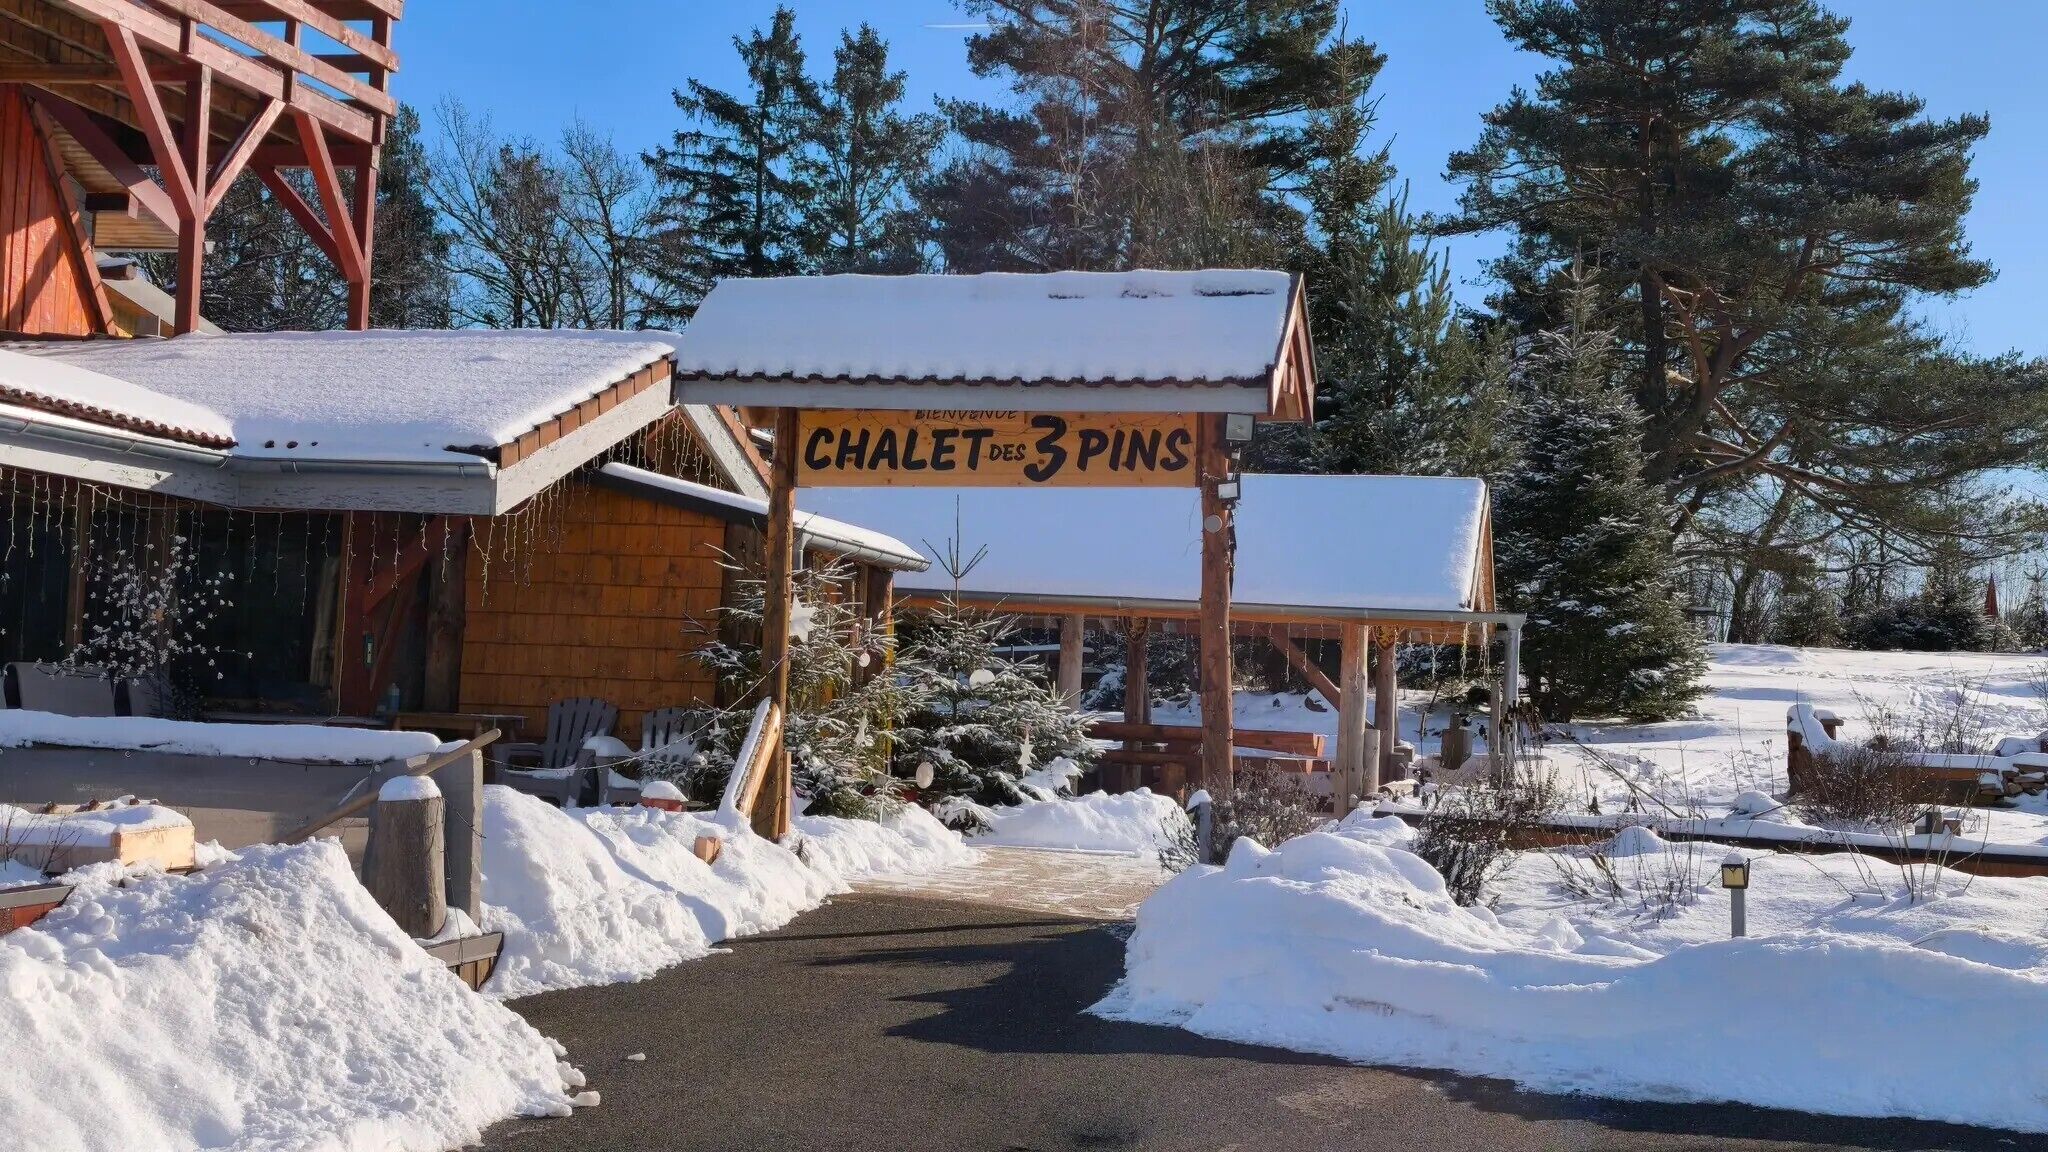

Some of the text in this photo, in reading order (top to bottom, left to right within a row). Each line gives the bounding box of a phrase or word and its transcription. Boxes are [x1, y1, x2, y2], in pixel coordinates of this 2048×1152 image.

[805, 415, 1192, 482] CHALET DES 3 PINS
